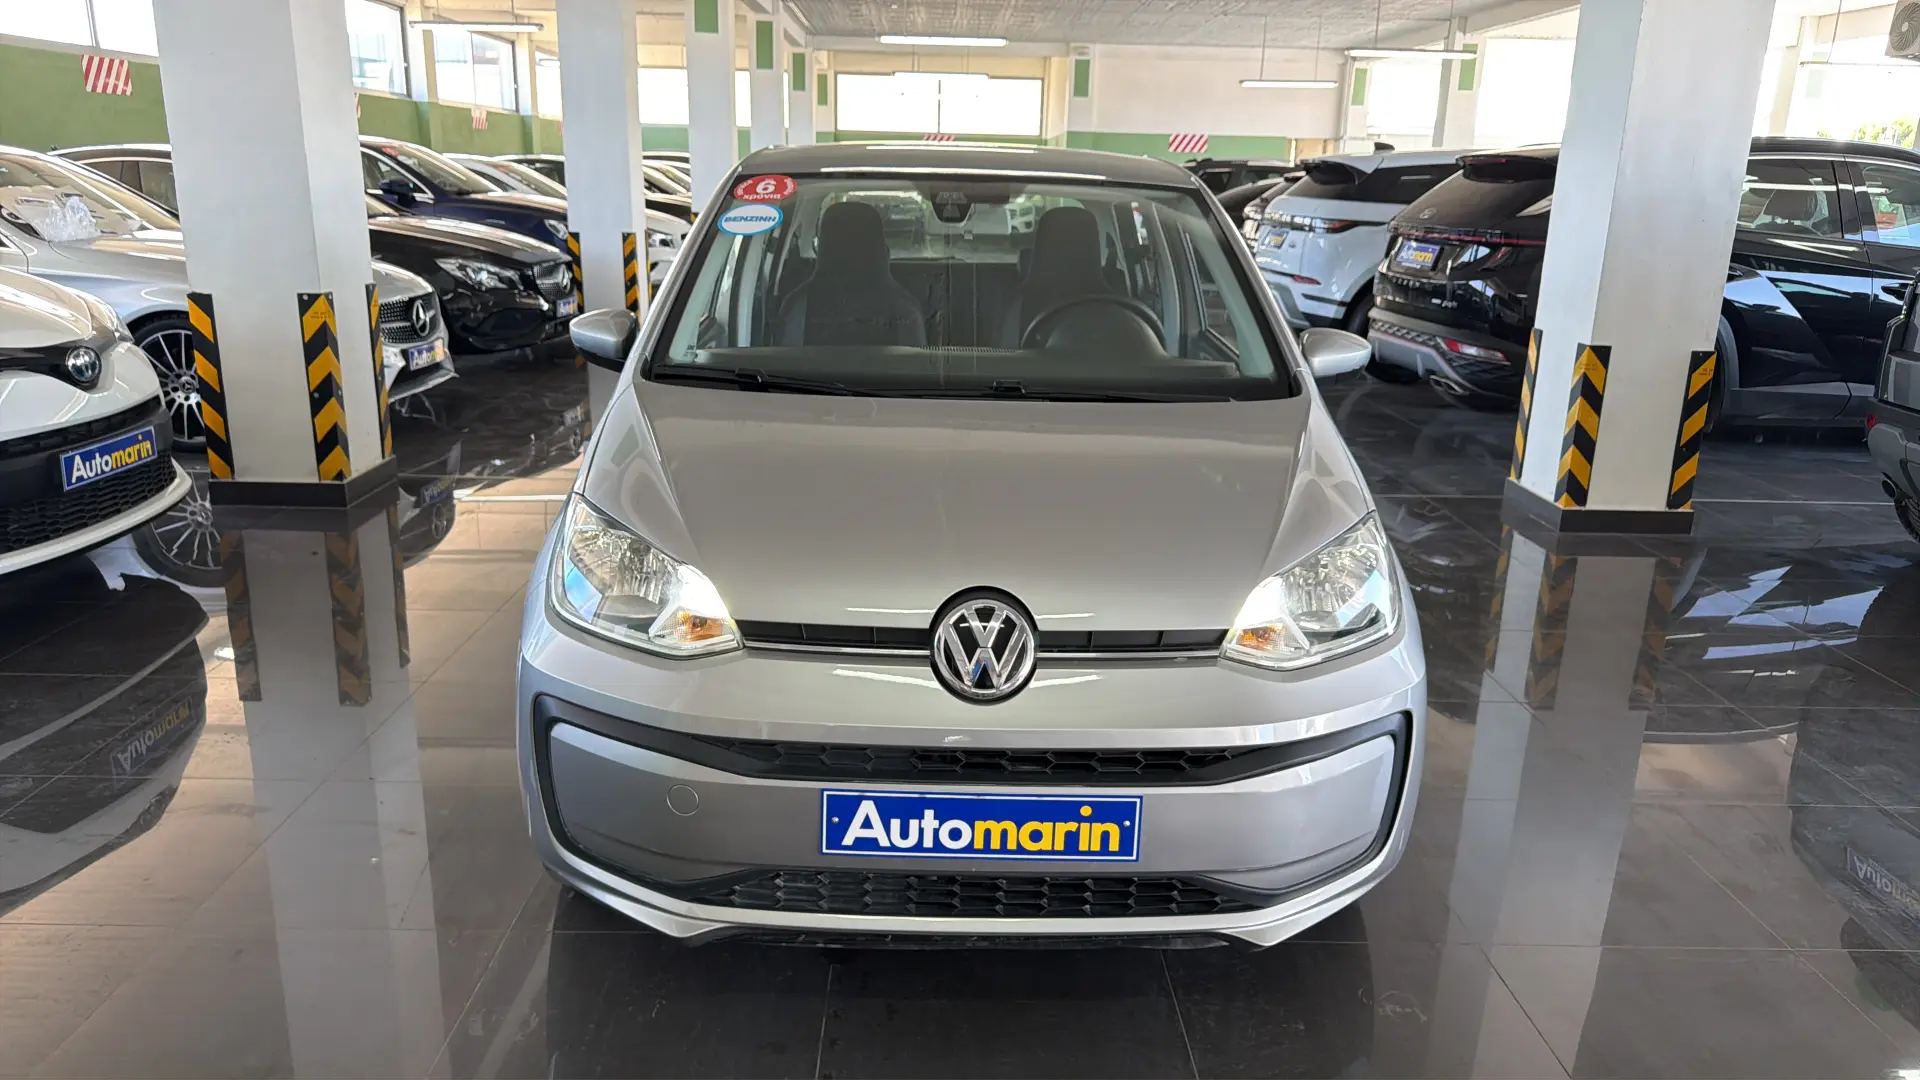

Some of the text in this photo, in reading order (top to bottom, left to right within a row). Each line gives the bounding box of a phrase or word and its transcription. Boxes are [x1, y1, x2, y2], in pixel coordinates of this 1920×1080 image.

[756, 179, 777, 194] 6
[71, 434, 153, 484] Automarin
[841, 799, 1121, 852] Automarin
